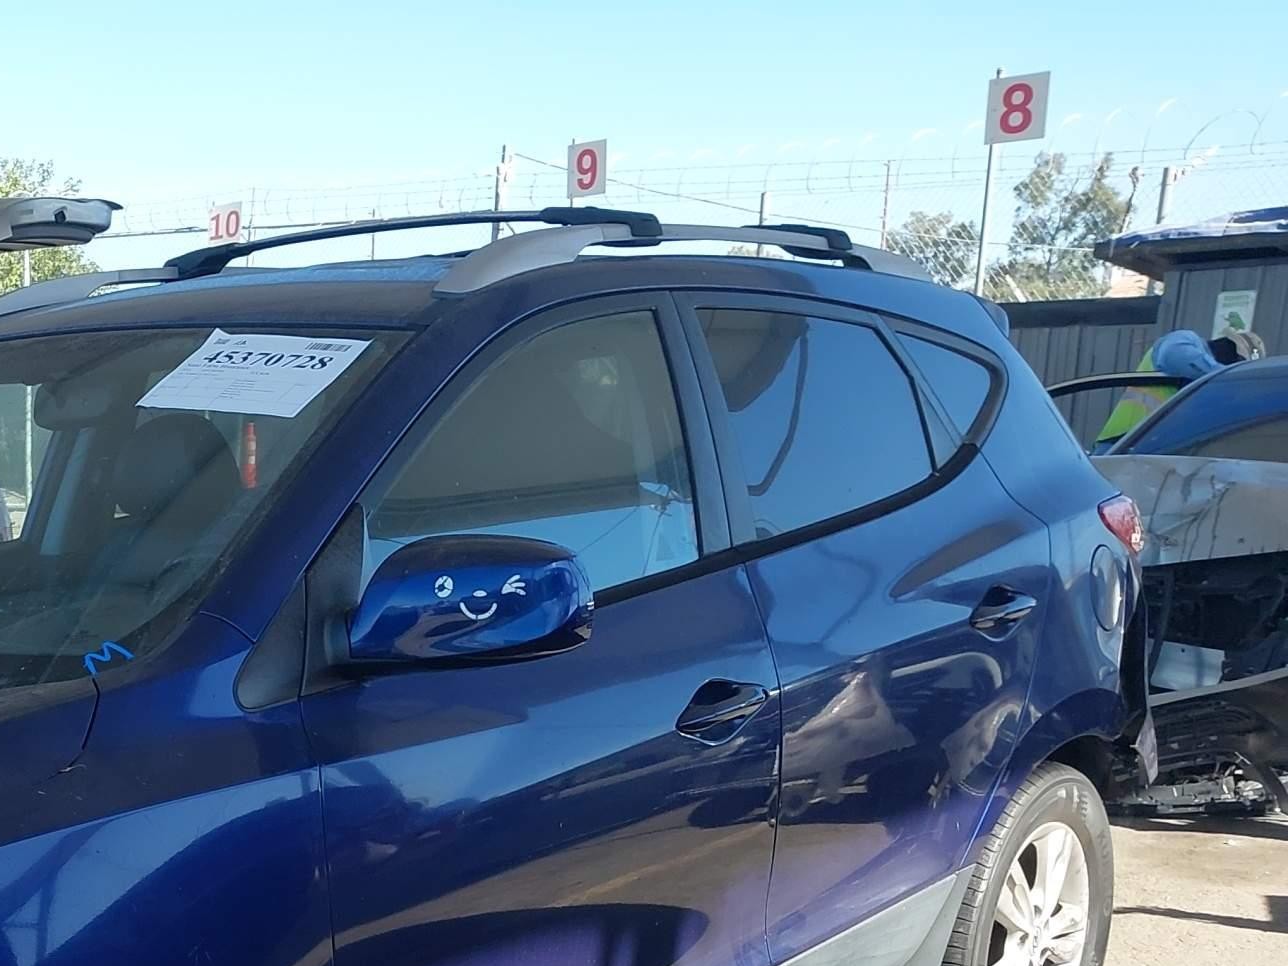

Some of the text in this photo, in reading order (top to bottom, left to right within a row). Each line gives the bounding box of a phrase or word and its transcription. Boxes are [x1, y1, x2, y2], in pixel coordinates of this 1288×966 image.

[999, 82, 1034, 134] 8
[576, 148, 598, 191] 9
[209, 209, 240, 241] 10
[202, 349, 334, 371] 45370728
